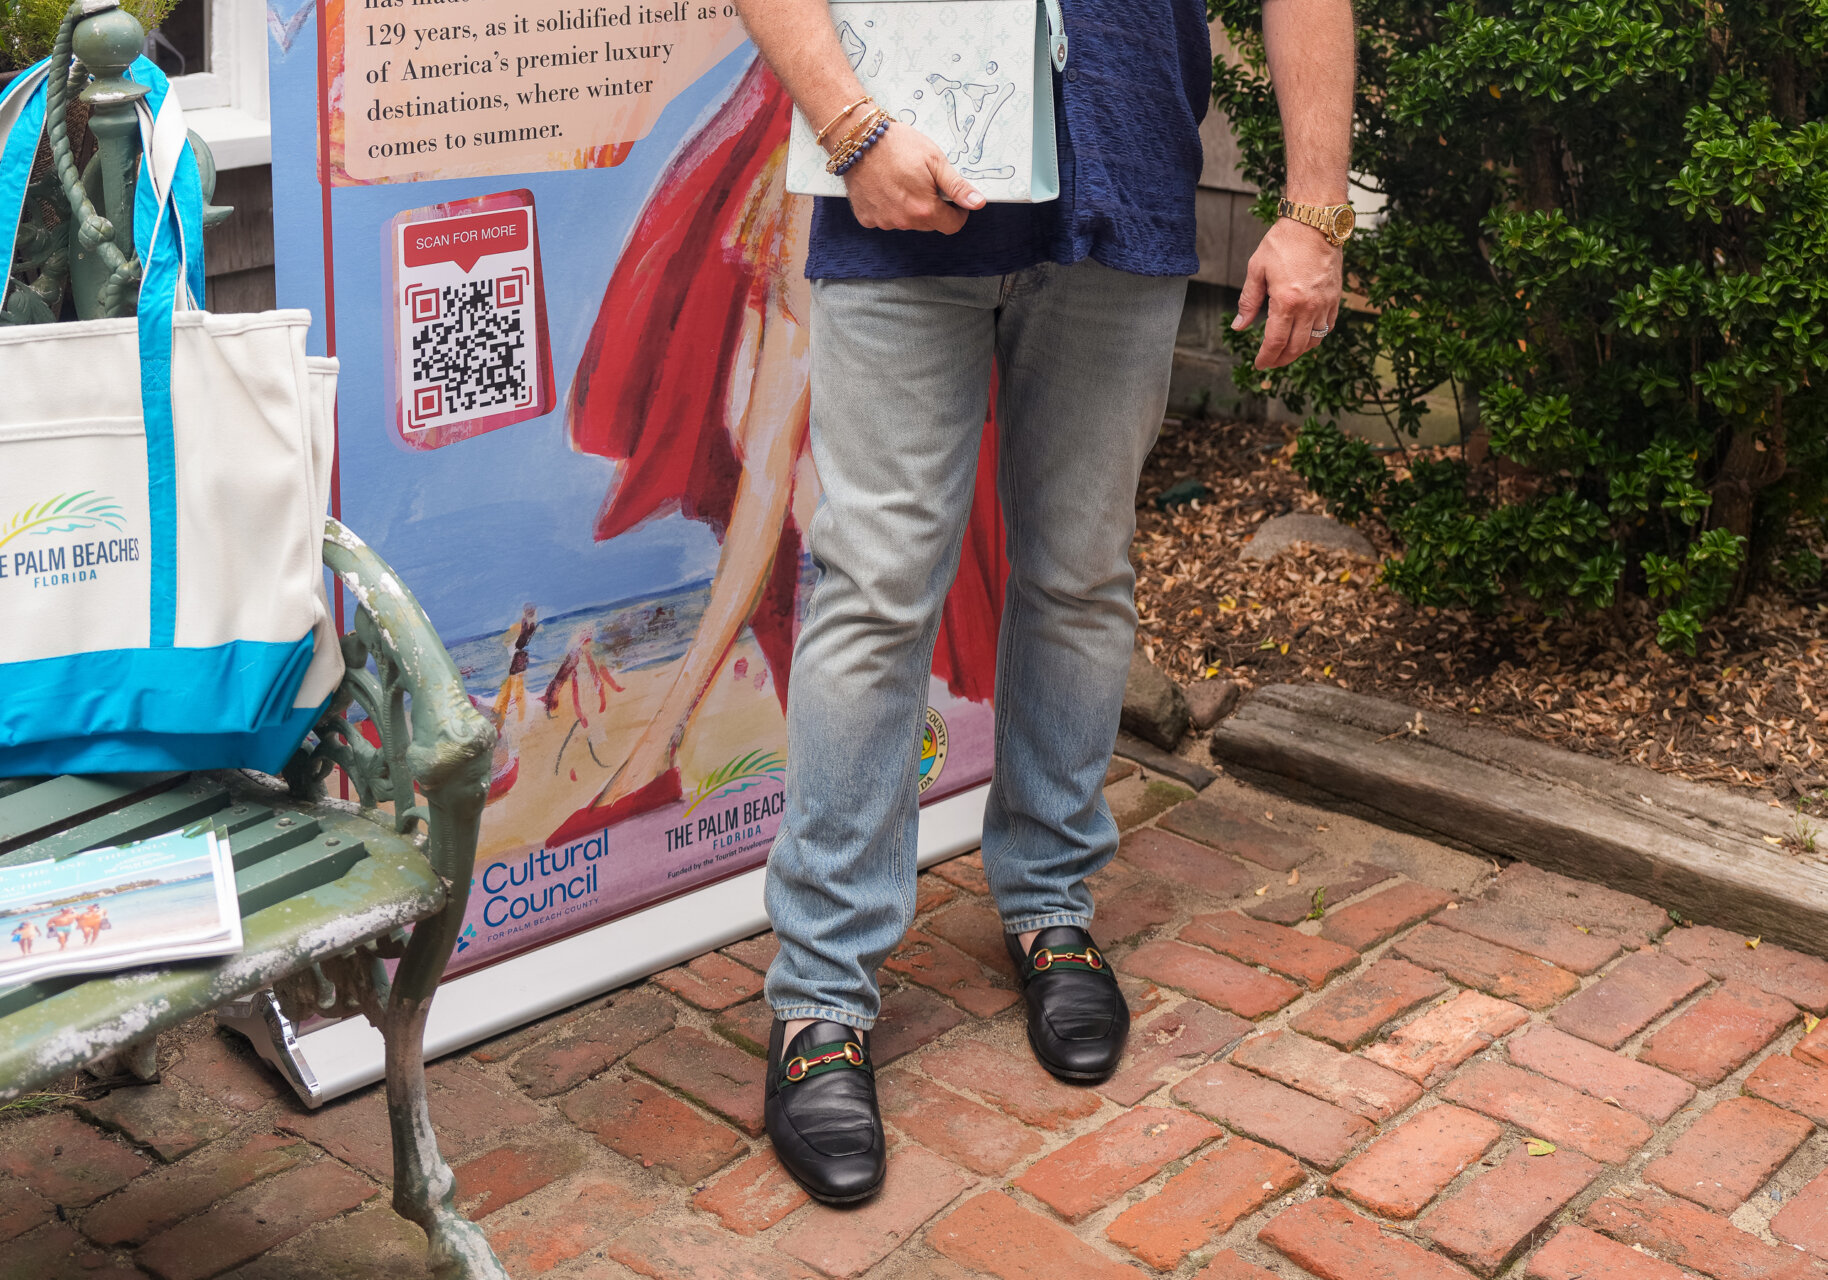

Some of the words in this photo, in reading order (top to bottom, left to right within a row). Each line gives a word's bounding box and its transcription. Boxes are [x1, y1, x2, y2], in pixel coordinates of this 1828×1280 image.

[365, 23, 407, 47] 129
[413, 24, 479, 51] years,
[485, 20, 508, 37] as
[513, 15, 530, 35] it
[536, 4, 633, 34] solidified
[637, 0, 690, 25] itself
[697, 5, 717, 20] as
[366, 59, 392, 85] of
[516, 45, 599, 77] premier
[604, 39, 675, 66] luxury
[367, 92, 510, 122] destinations,
[516, 83, 580, 106] where
[586, 75, 654, 100] winter
[367, 139, 438, 160] comes
[445, 131, 467, 151] to
[472, 124, 564, 147] summer.
[415, 234, 451, 251] SCAN
[453, 229, 479, 245] FOR
[481, 224, 517, 241] MORE
[14, 546, 66, 577] PALM
[72, 537, 140, 569] BEACHES
[34, 569, 98, 588] FLORIDA
[664, 822, 694, 852] THE
[698, 806, 739, 842] PALM
[713, 824, 762, 850] FLORIDA
[482, 827, 608, 894] Cultural
[667, 864, 693, 879] Funded
[715, 849, 737, 862] Tourist
[484, 863, 597, 927] Council
[487, 930, 505, 942] FOR
[507, 921, 531, 936] PALM
[533, 912, 562, 926] BEACH
[564, 897, 600, 915] COUNTY
